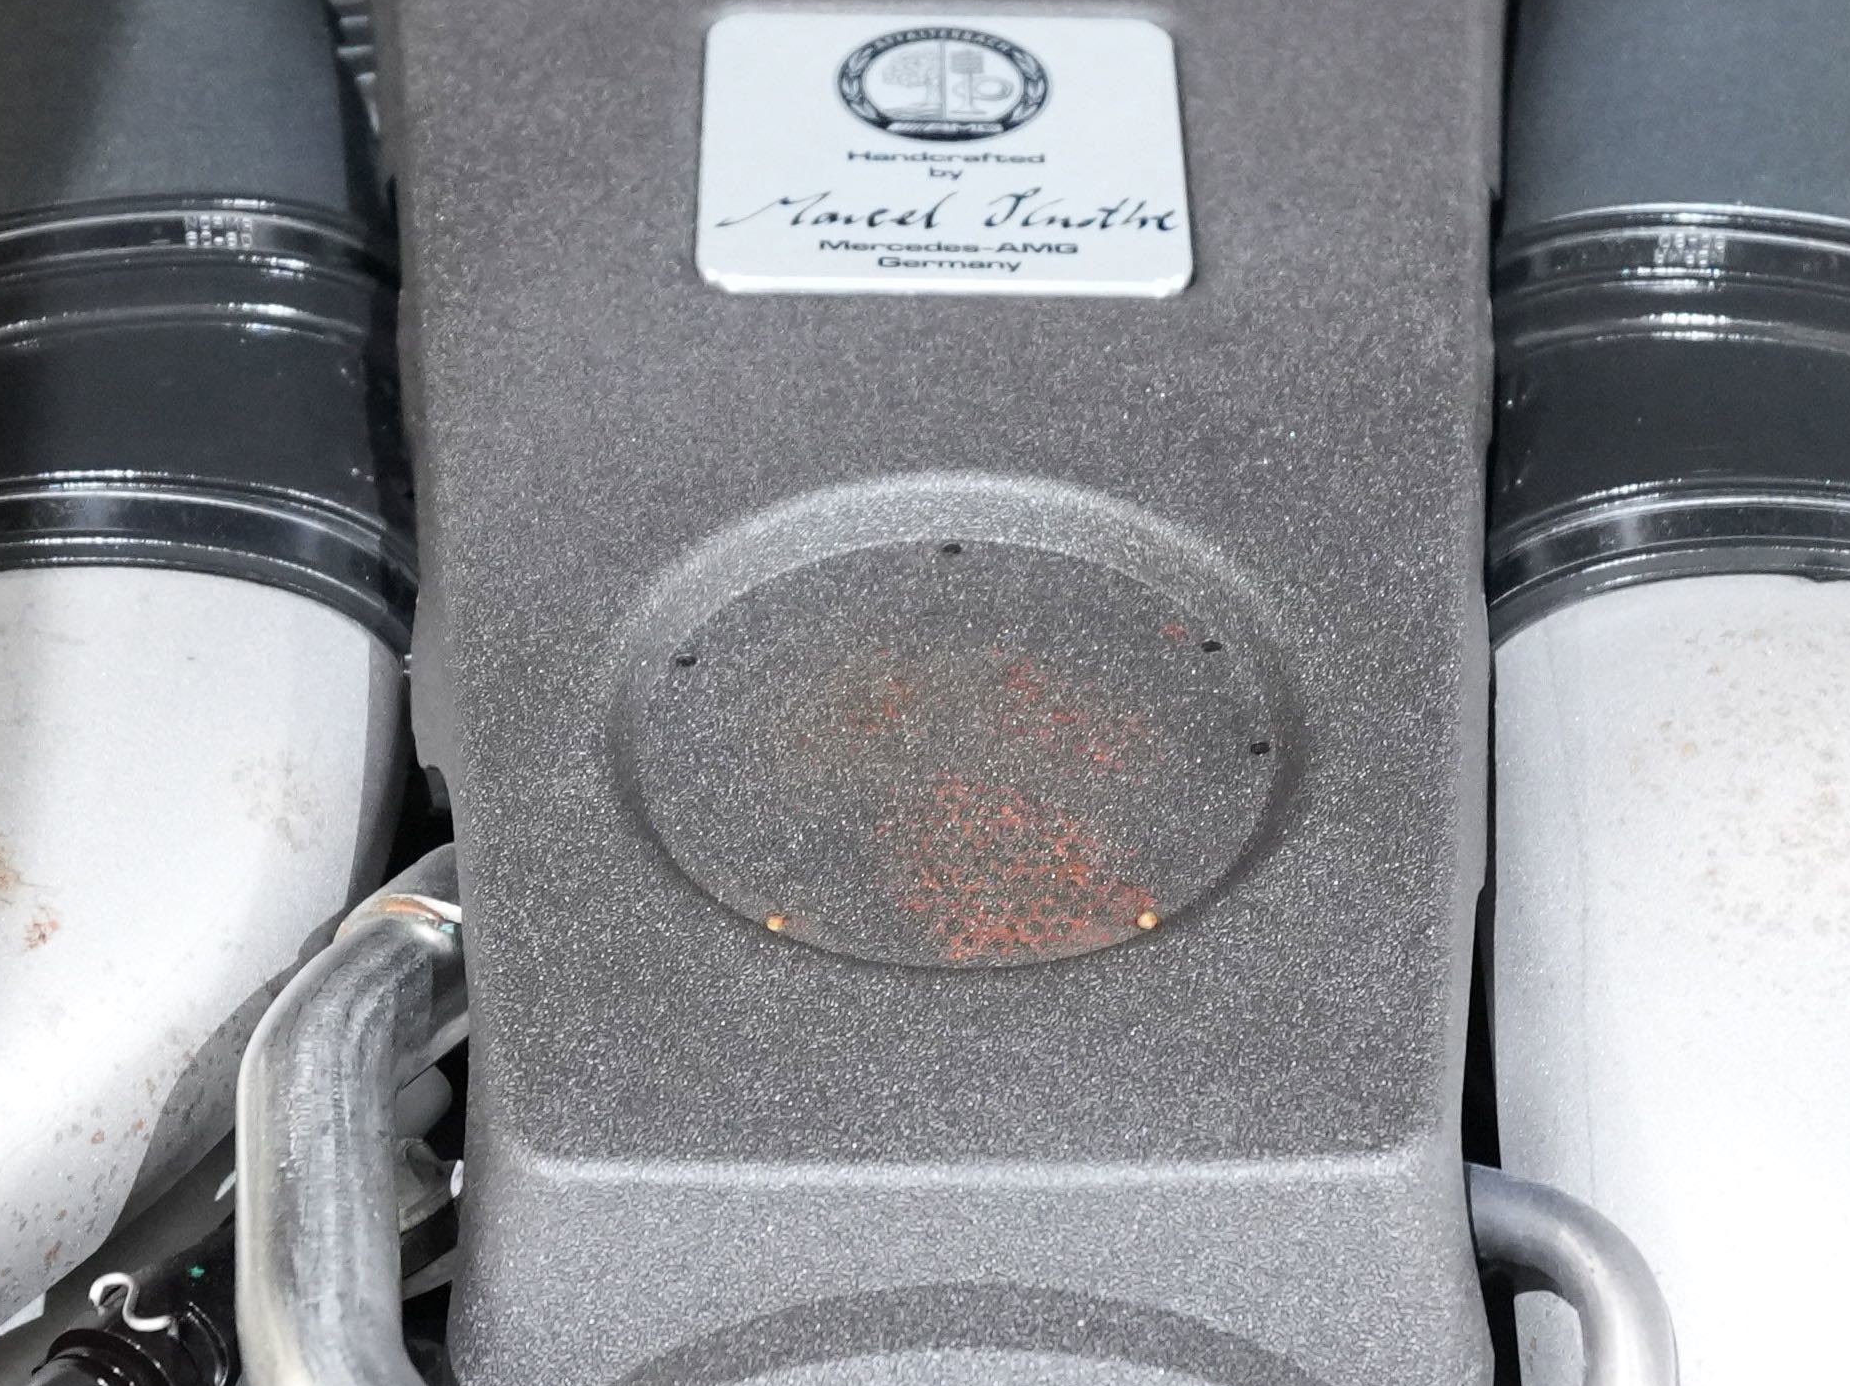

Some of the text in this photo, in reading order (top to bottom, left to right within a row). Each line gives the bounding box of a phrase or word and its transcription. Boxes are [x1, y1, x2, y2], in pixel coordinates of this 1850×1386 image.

[847, 151, 1045, 163] Handcrafted
[929, 167, 963, 181] by
[819, 240, 1079, 255] Mercedes-AMG
[877, 256, 1022, 273] Germany
